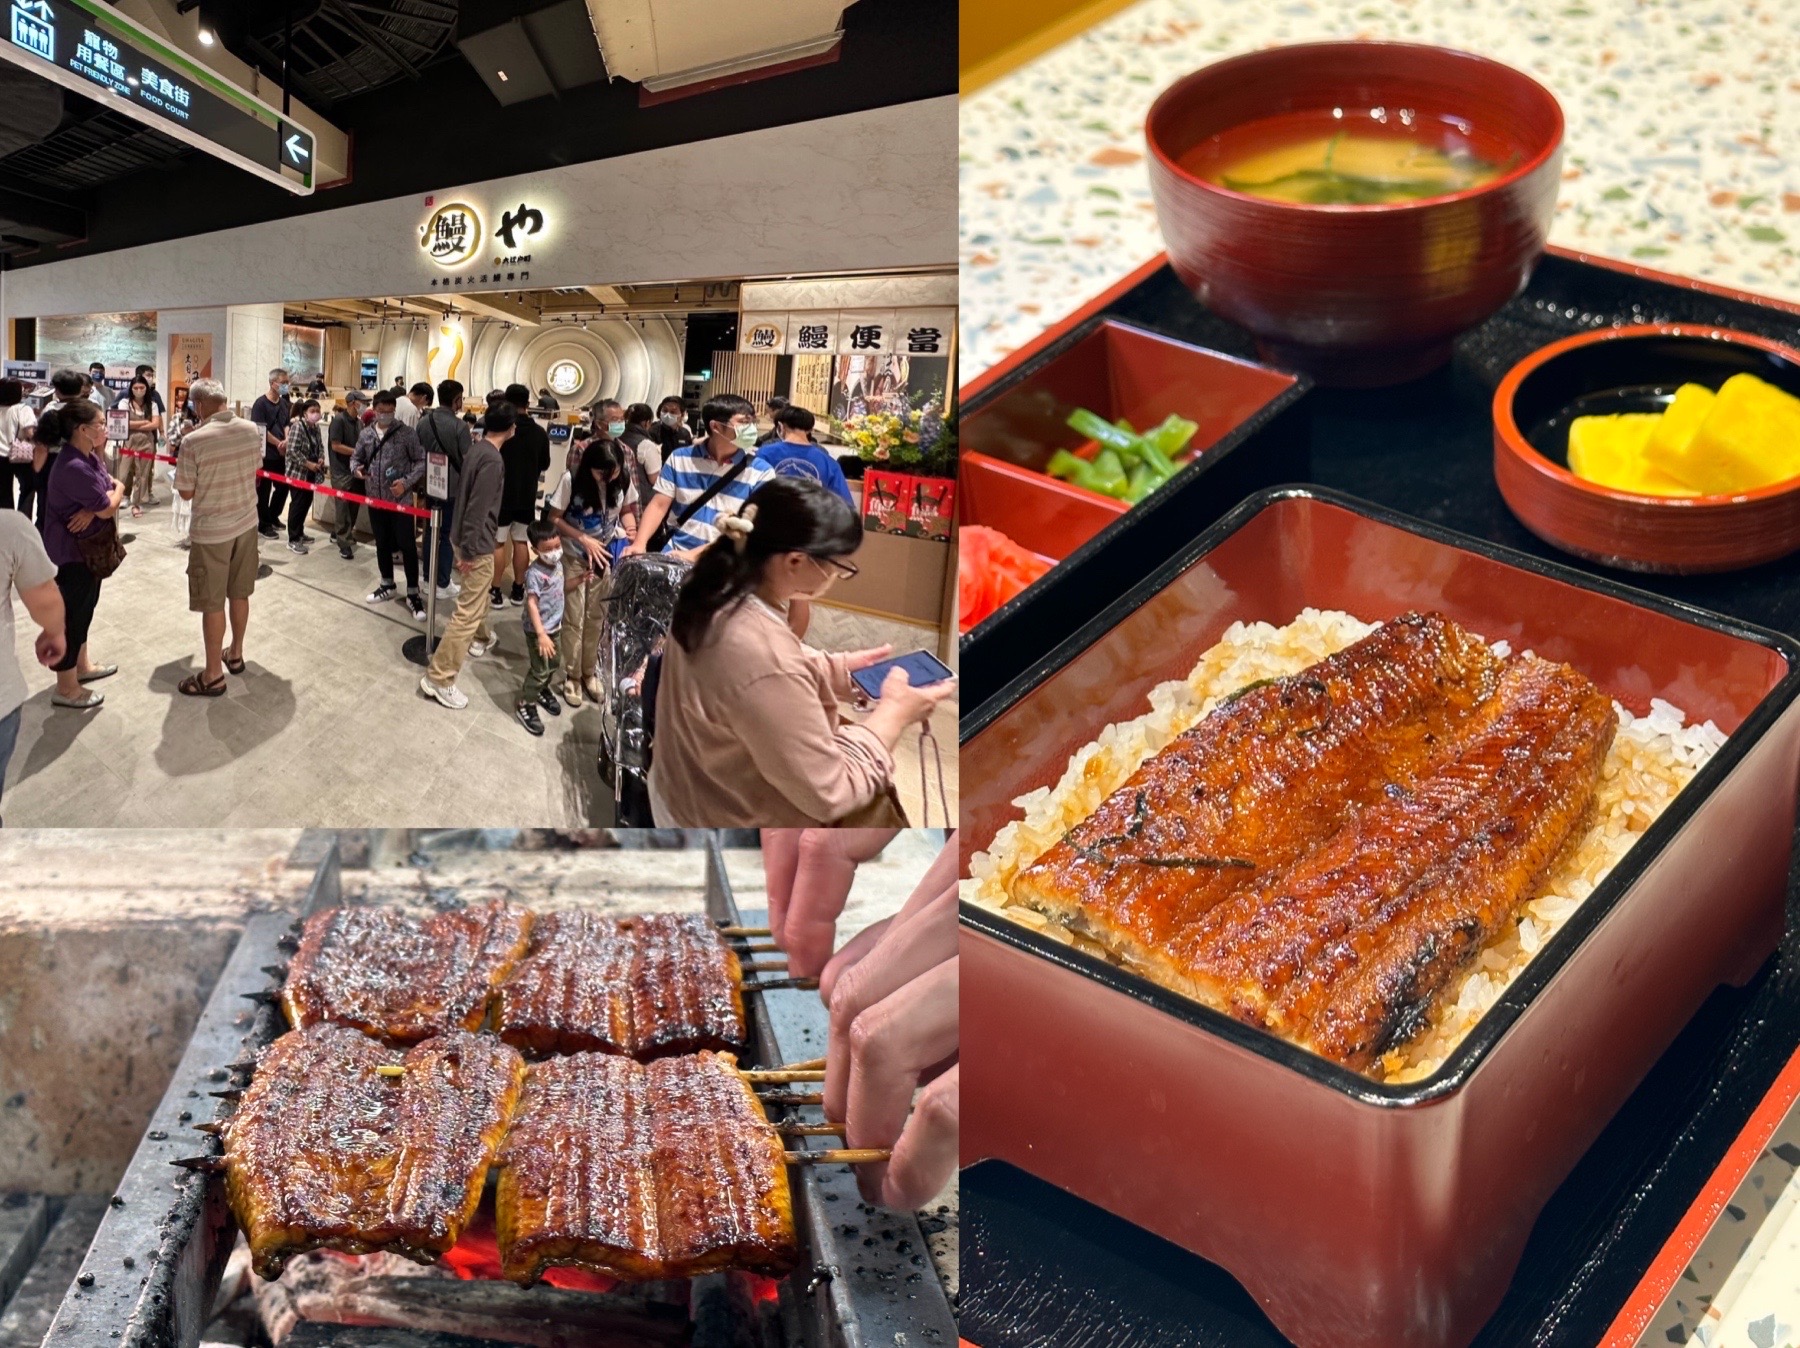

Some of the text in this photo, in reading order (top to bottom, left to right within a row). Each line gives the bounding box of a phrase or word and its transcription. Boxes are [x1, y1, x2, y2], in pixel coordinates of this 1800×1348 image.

[76, 43, 126, 81] 用餐區
[84, 29, 118, 60] 寵物
[70, 58, 131, 95] PET FRIENDLY ZONE
[141, 67, 190, 107] 美食街
[140, 89, 190, 120] FOOD COURT
[495, 203, 544, 248] や
